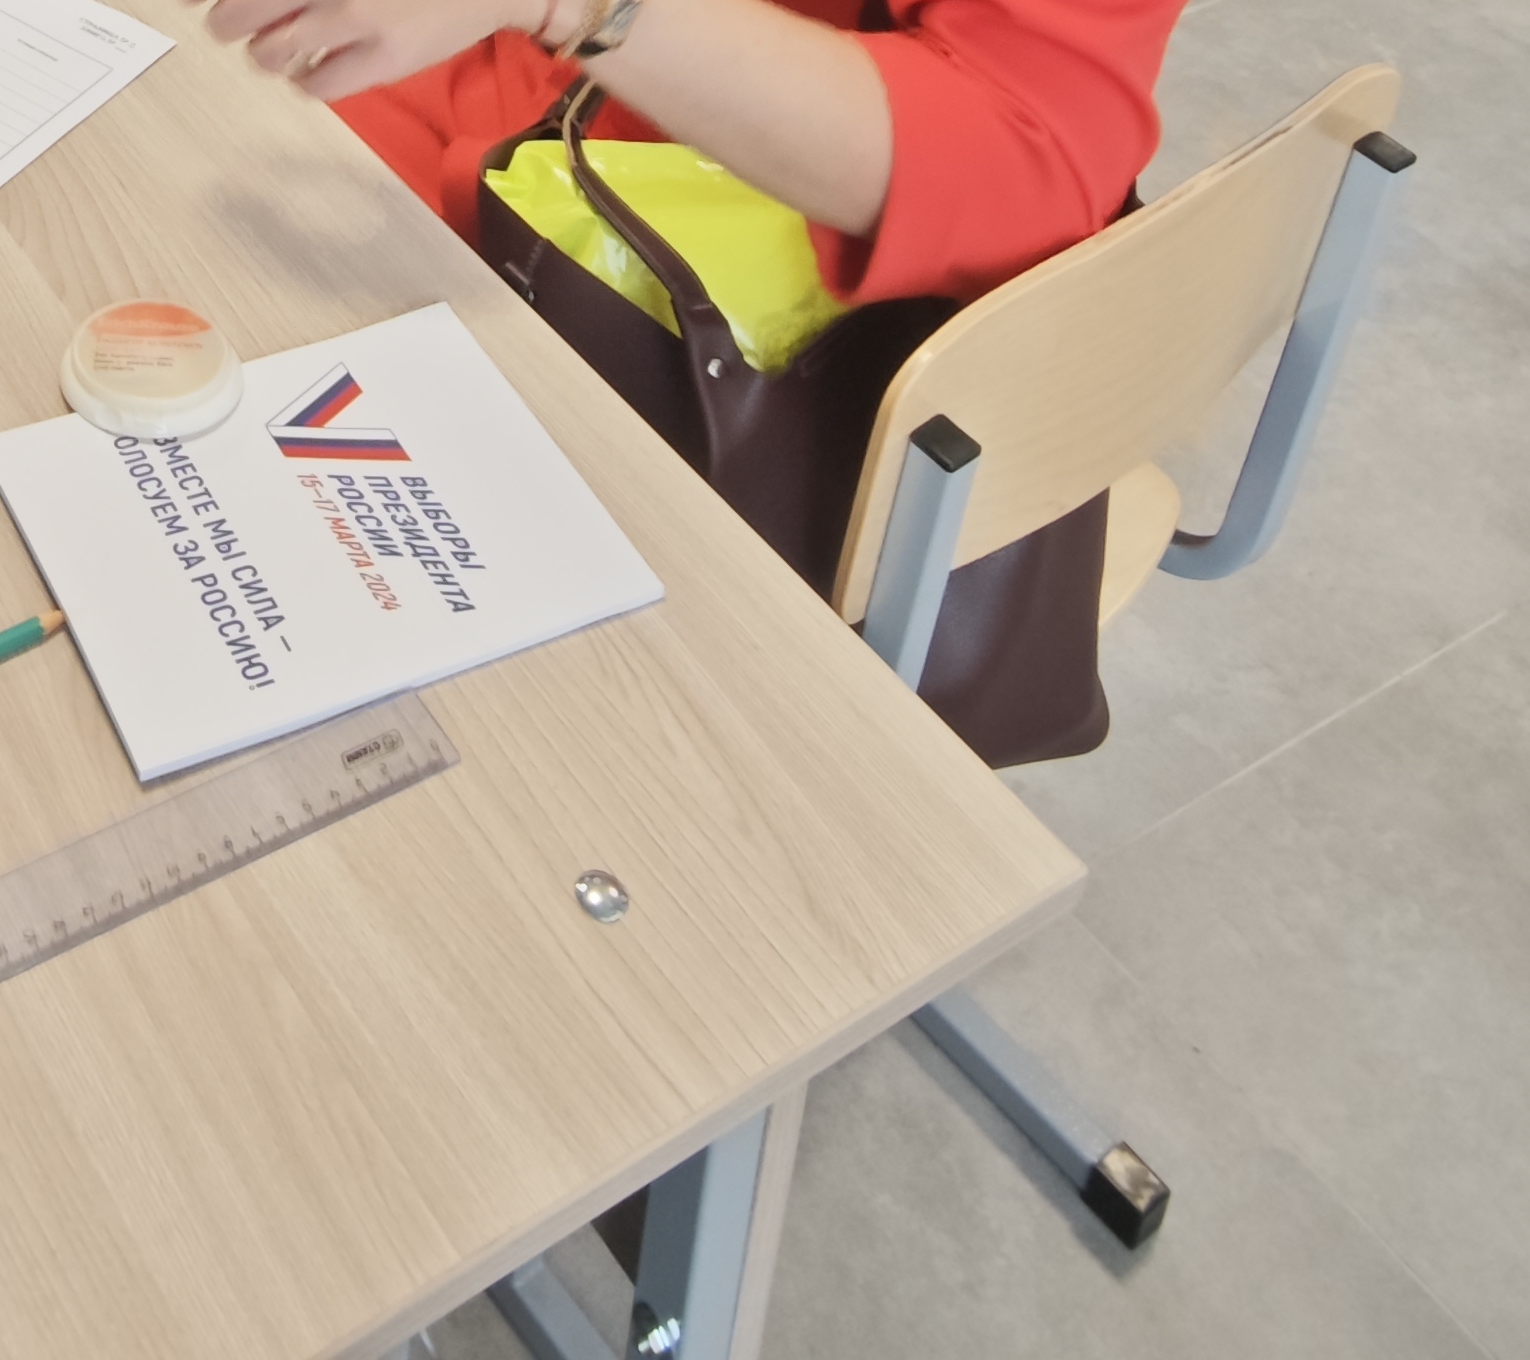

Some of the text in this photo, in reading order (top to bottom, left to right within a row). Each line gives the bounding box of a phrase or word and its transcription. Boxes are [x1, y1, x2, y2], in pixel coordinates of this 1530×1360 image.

[113, 436, 189, 536] ОЛОСУЕМ
[172, 539, 206, 570] ЗА
[191, 573, 275, 691] РОССИЮ!
[324, 516, 375, 568] МАРТА
[359, 572, 402, 611] 2024
[327, 474, 404, 557] РОССИИ
[363, 475, 476, 613] ПРЕЗИДЕНТА
[400, 476, 486, 570] ВЫБОРЫ
[203, 518, 247, 561] МЫ
[231, 564, 286, 632] СИЛА
